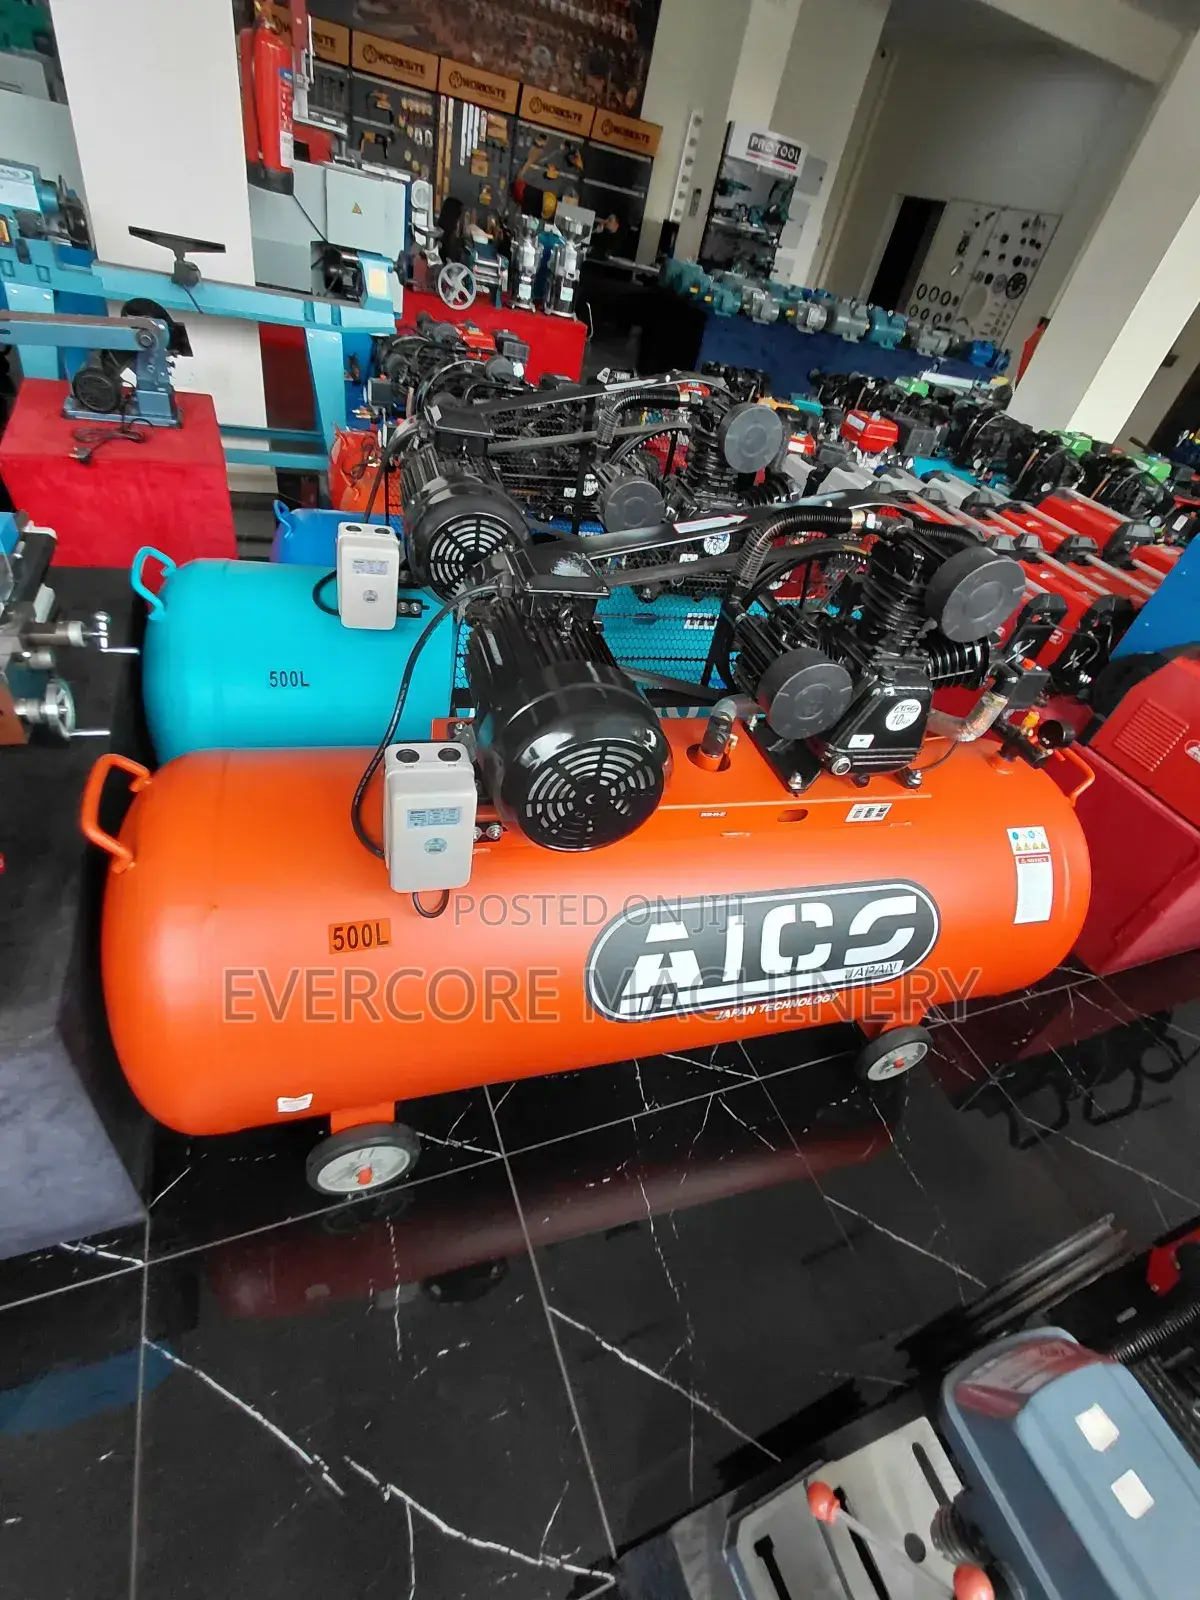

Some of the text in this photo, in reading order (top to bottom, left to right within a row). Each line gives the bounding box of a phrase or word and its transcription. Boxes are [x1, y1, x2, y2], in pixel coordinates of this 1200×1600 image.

[269, 670, 310, 688] 500L
[332, 921, 390, 952] 500L
[618, 895, 917, 996] AICS
[844, 961, 899, 979] JAPAN
[714, 992, 840, 1021] JAPAN TECHNOLOGY
